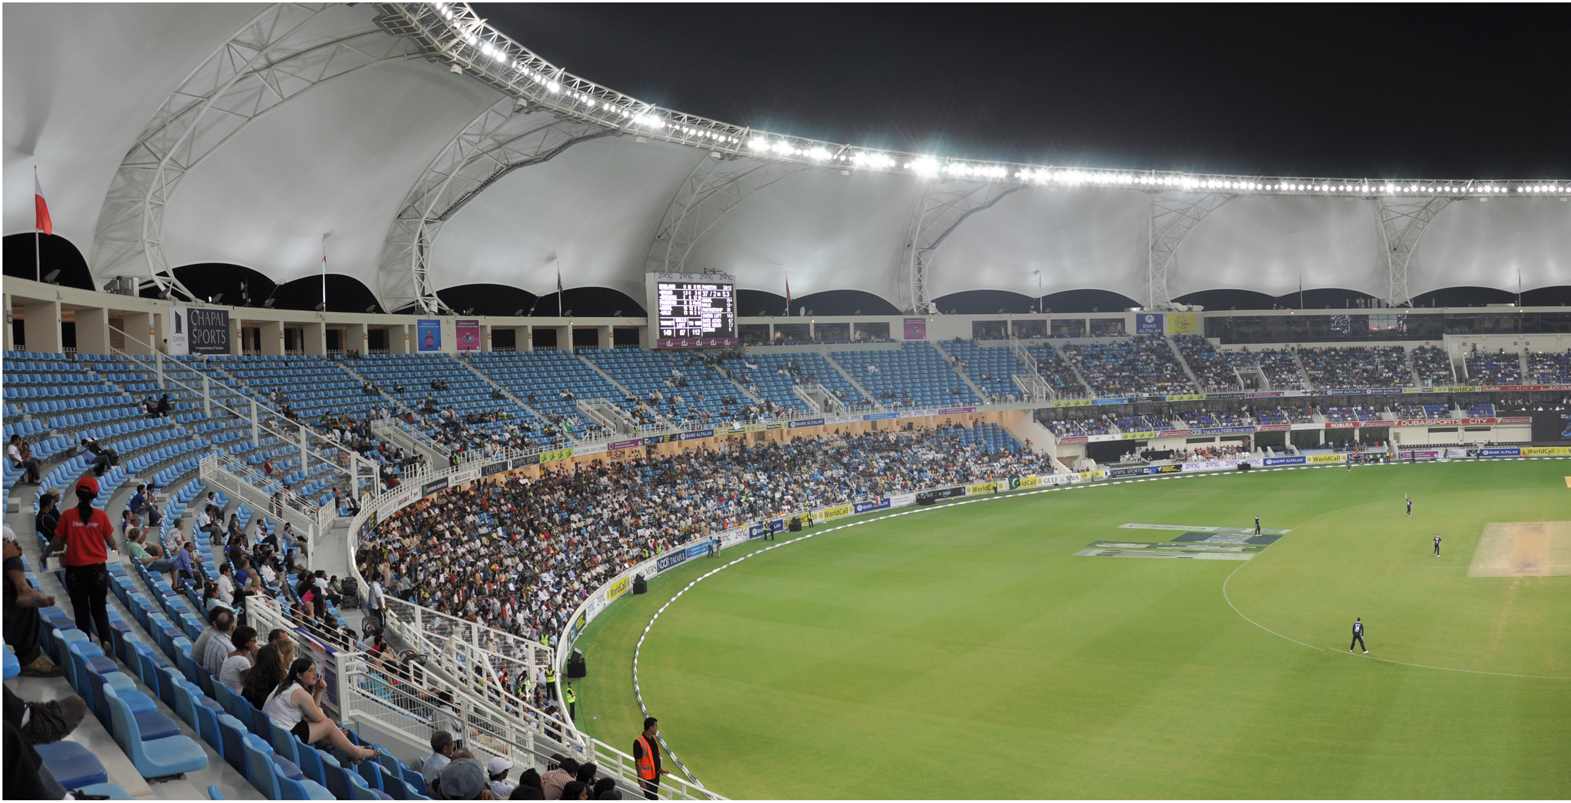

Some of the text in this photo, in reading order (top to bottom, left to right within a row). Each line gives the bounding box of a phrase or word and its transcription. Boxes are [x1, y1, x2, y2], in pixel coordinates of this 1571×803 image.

[190, 310, 226, 326] CHAPAL
[192, 329, 226, 344] SPORTS
[972, 484, 995, 493] WorldCa
[824, 506, 849, 518] WorldCall
[610, 579, 626, 598] WorldCall
